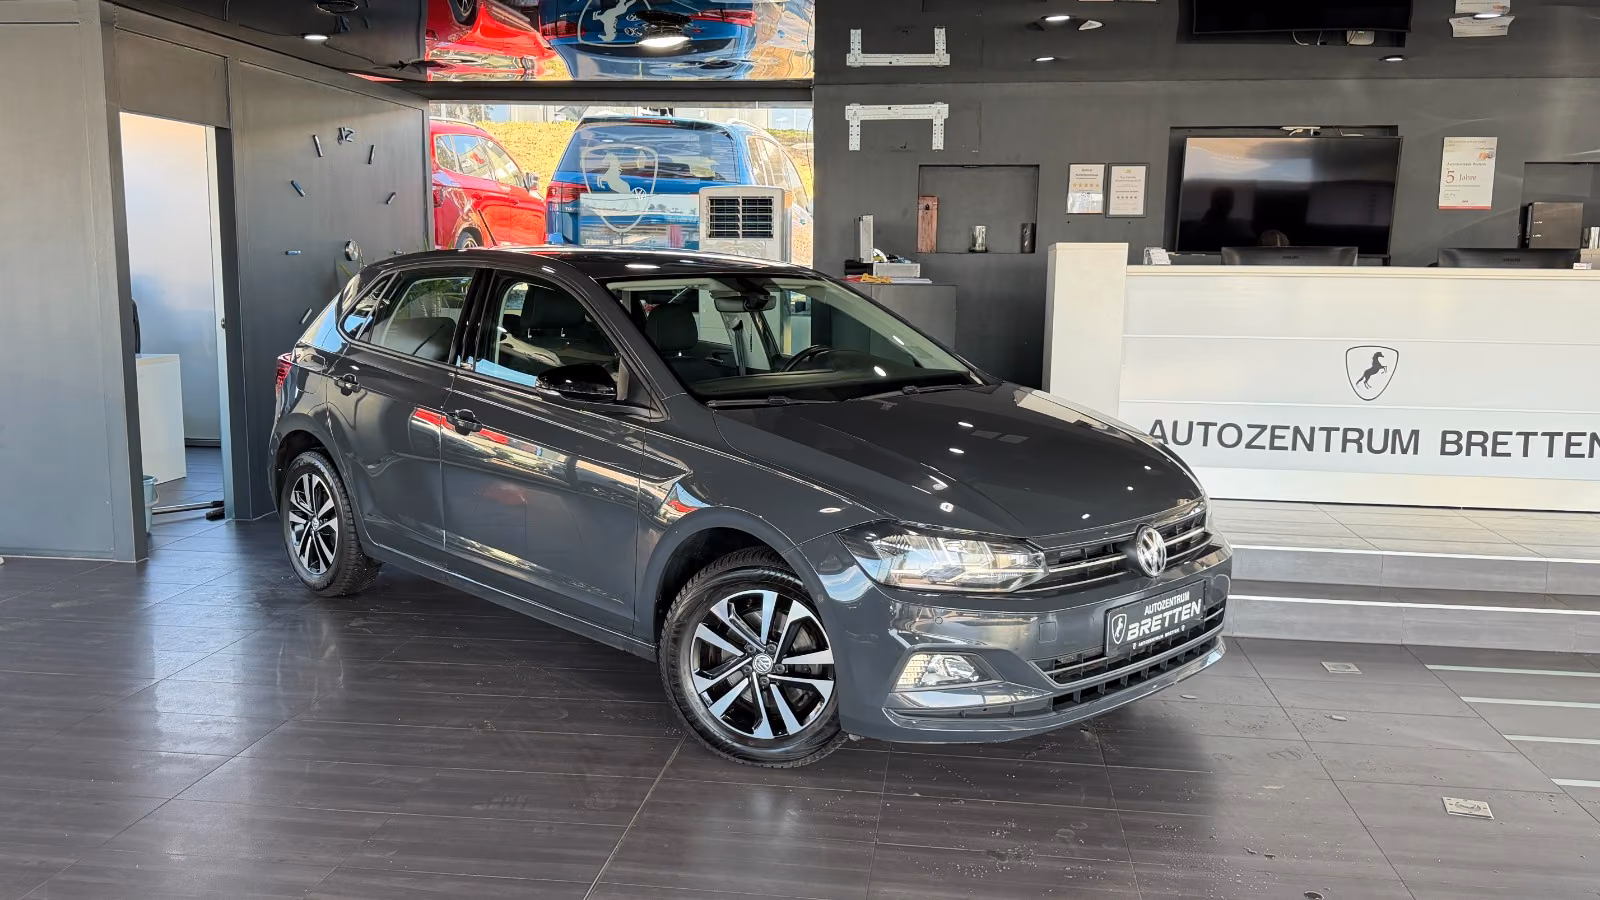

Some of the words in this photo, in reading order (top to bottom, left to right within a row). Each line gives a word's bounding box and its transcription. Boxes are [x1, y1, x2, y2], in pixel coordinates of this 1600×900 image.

[1445, 170, 1455, 184] 5
[1459, 173, 1477, 182] Jahre
[1149, 419, 1420, 456] AUTOZENTRUM
[1144, 591, 1190, 616] AUTOZENTRUM
[1127, 598, 1202, 641] BRETTEN
